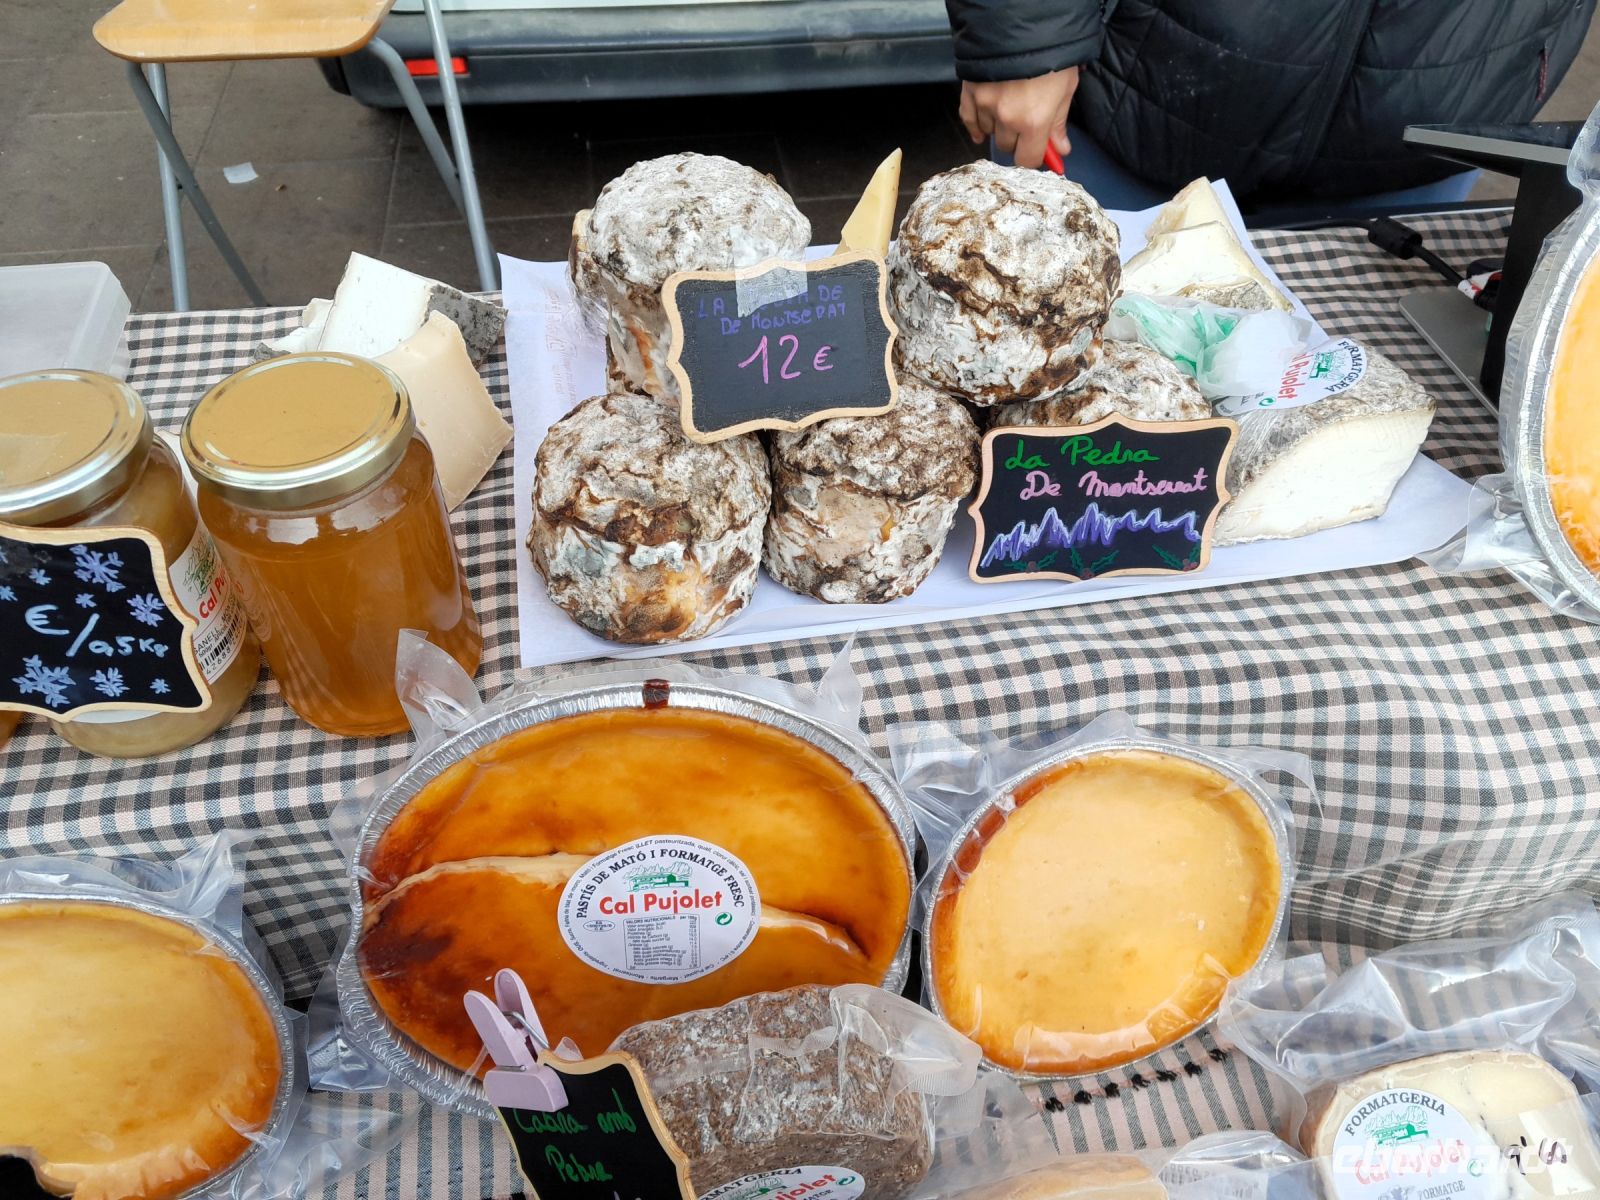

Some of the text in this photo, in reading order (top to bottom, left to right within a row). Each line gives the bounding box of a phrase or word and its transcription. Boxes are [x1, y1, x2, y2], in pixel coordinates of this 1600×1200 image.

[698, 284, 844, 319] LA DE
[721, 317, 743, 335] DE
[1004, 435, 1160, 470] La Pedra
[1019, 467, 1209, 500] De Montserrat
[199, 588, 218, 619] Cal
[576, 848, 745, 919] PASTÍS DE MATÓ I FORMATGE FRESC
[599, 888, 723, 915] Cal Pujolet
[597, 1087, 637, 1135] amb
[1344, 1091, 1446, 1136] FORMATGERIA
[545, 1144, 614, 1183] Pebre
